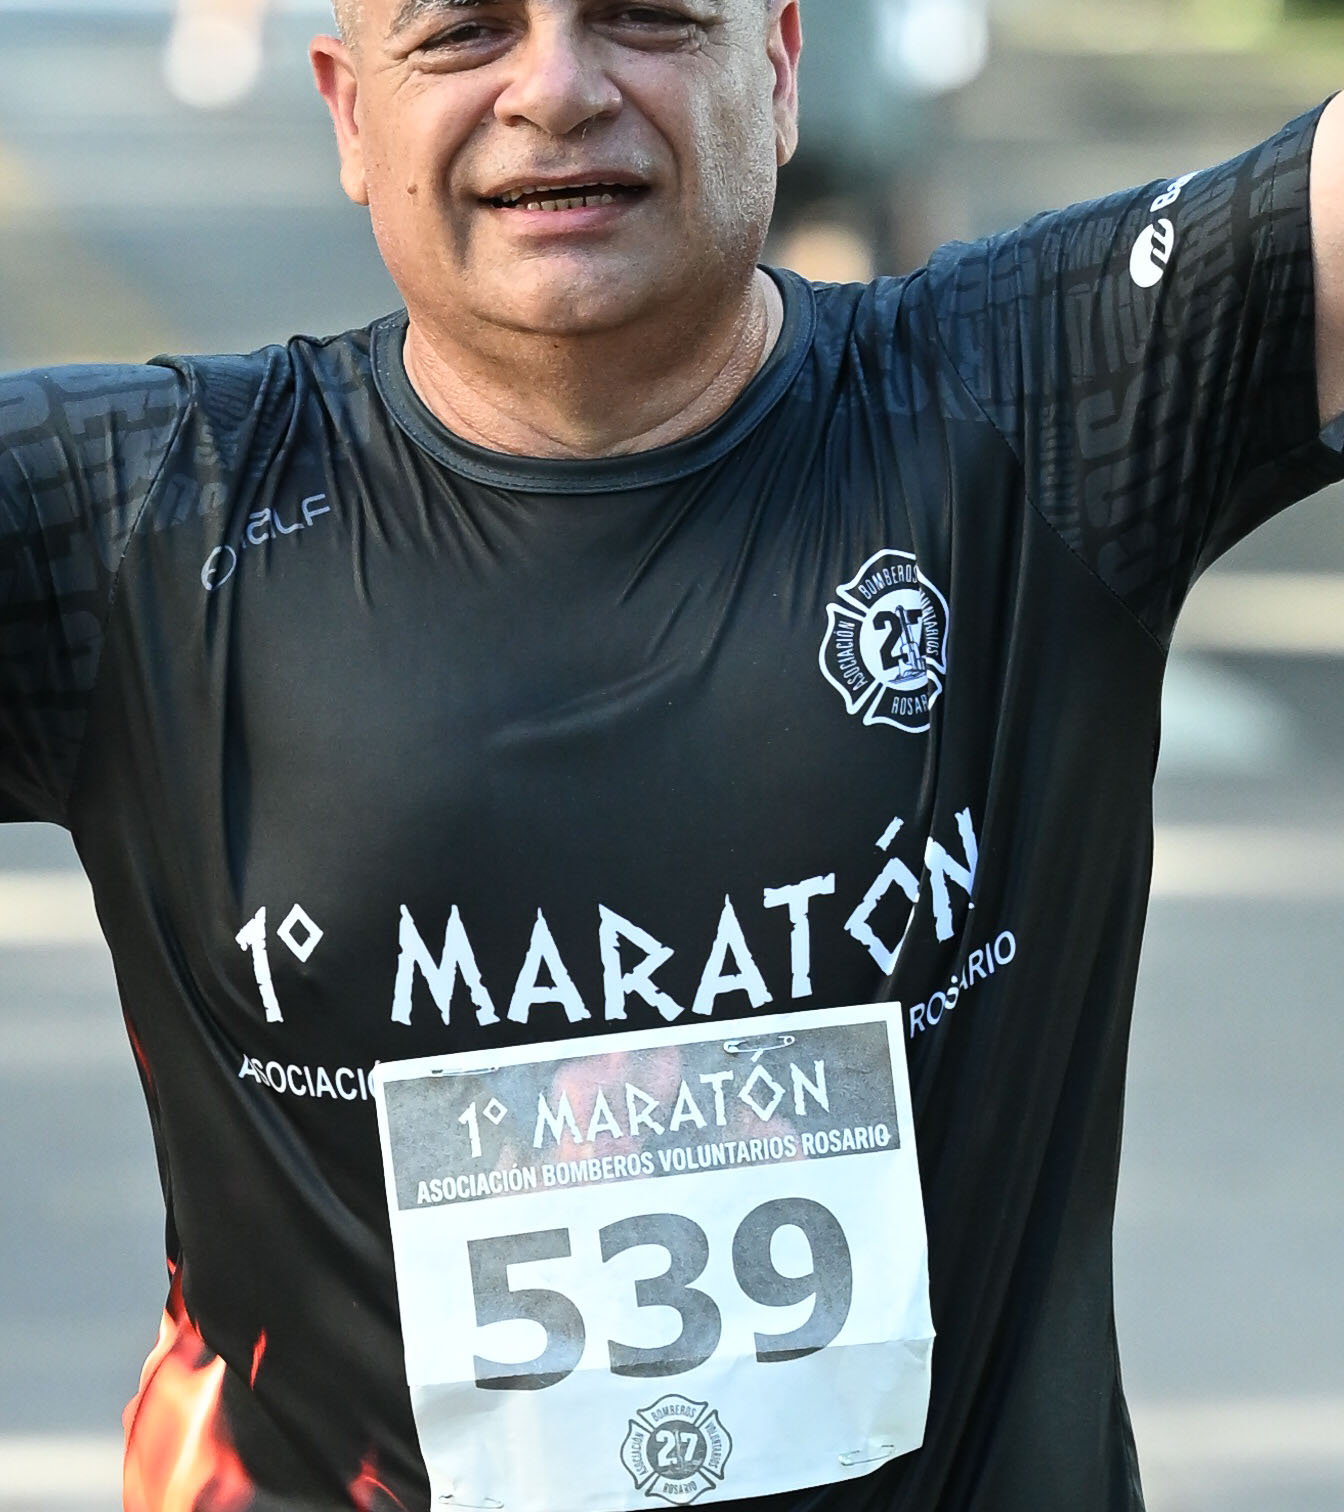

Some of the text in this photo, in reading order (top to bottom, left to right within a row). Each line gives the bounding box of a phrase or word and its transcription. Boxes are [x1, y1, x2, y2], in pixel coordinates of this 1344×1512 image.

[858, 564, 918, 600] BOMBEROS
[834, 619, 868, 691] ASOCIACIÓN
[891, 694, 930, 716] ROSAR
[392, 807, 980, 1026] MARATÓN
[238, 1053, 375, 1101] ASOCIACI
[532, 1048, 831, 1149] MARATÓN
[416, 1123, 892, 1205] ASOCIACIÓN BOMBEROS VOLUNTARIOS ROSARIO
[466, 1196, 854, 1392] 539
[655, 1429, 699, 1468] 27
